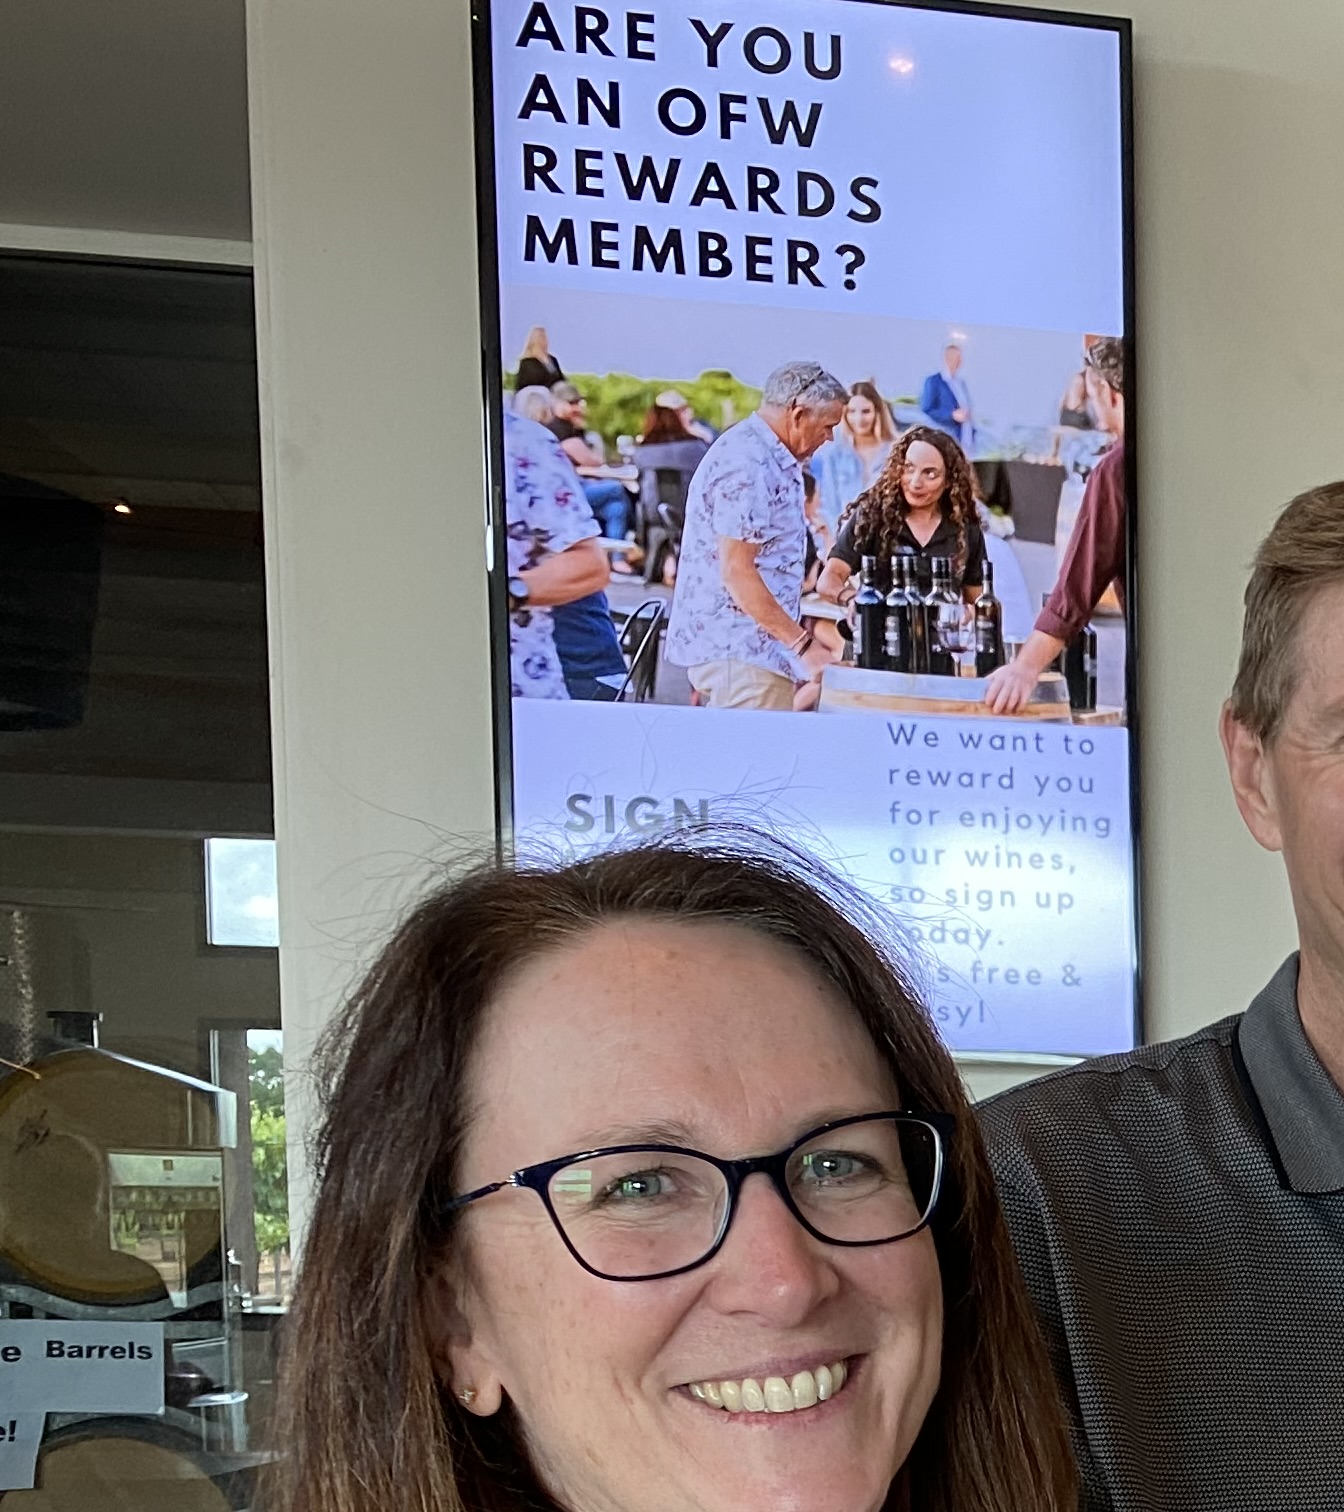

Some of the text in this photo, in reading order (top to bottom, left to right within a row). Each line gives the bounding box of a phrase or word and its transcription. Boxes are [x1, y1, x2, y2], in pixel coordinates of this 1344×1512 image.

[515, 1, 842, 81] ARE YOU
[517, 72, 823, 149] AN OFW
[521, 142, 882, 224] REWARDS
[523, 214, 866, 291] MEMBER?
[887, 721, 1096, 756] We want to
[888, 765, 1095, 797] reward you
[563, 792, 710, 836] SIGN
[889, 800, 1111, 839] for enjoying
[889, 845, 1077, 875] our wines,
[889, 881, 1075, 915] so sign up
[904, 920, 1005, 950] oday.
[970, 959, 1043, 985] free
[1061, 963, 1082, 988] &
[937, 999, 985, 1028] sy!
[46, 1340, 153, 1360] Barrels
